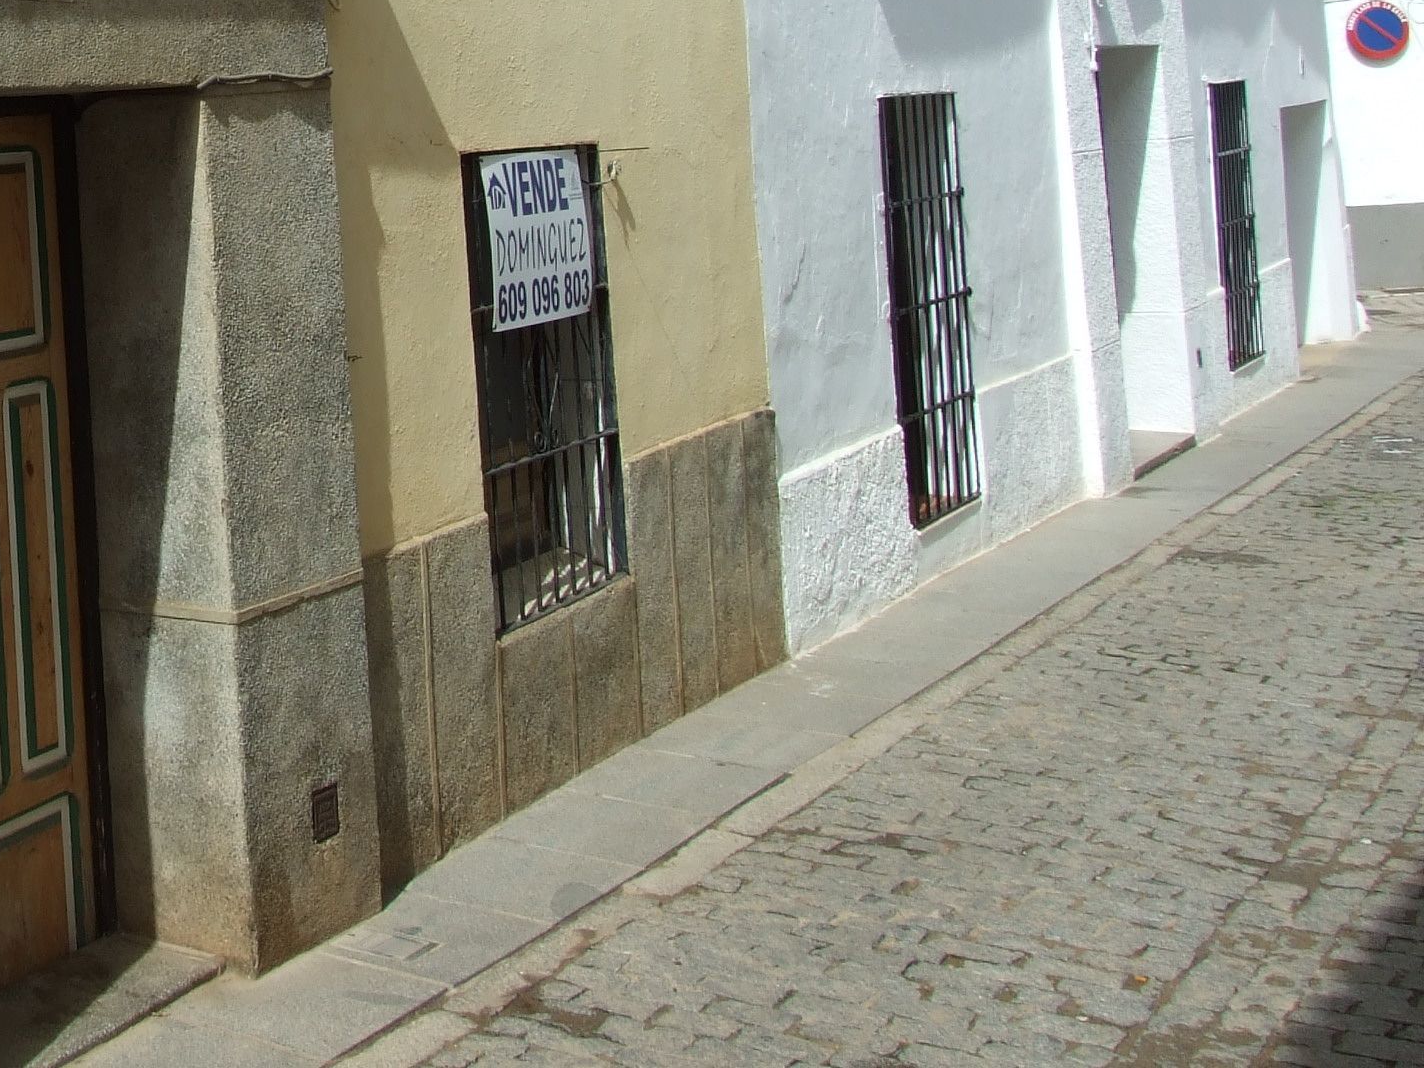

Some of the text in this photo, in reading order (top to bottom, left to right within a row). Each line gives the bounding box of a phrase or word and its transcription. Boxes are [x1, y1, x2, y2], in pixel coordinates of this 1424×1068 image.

[502, 158, 569, 217] VENDE
[495, 218, 586, 277] DOMINGUEZ
[498, 269, 589, 323] 609 096 803
